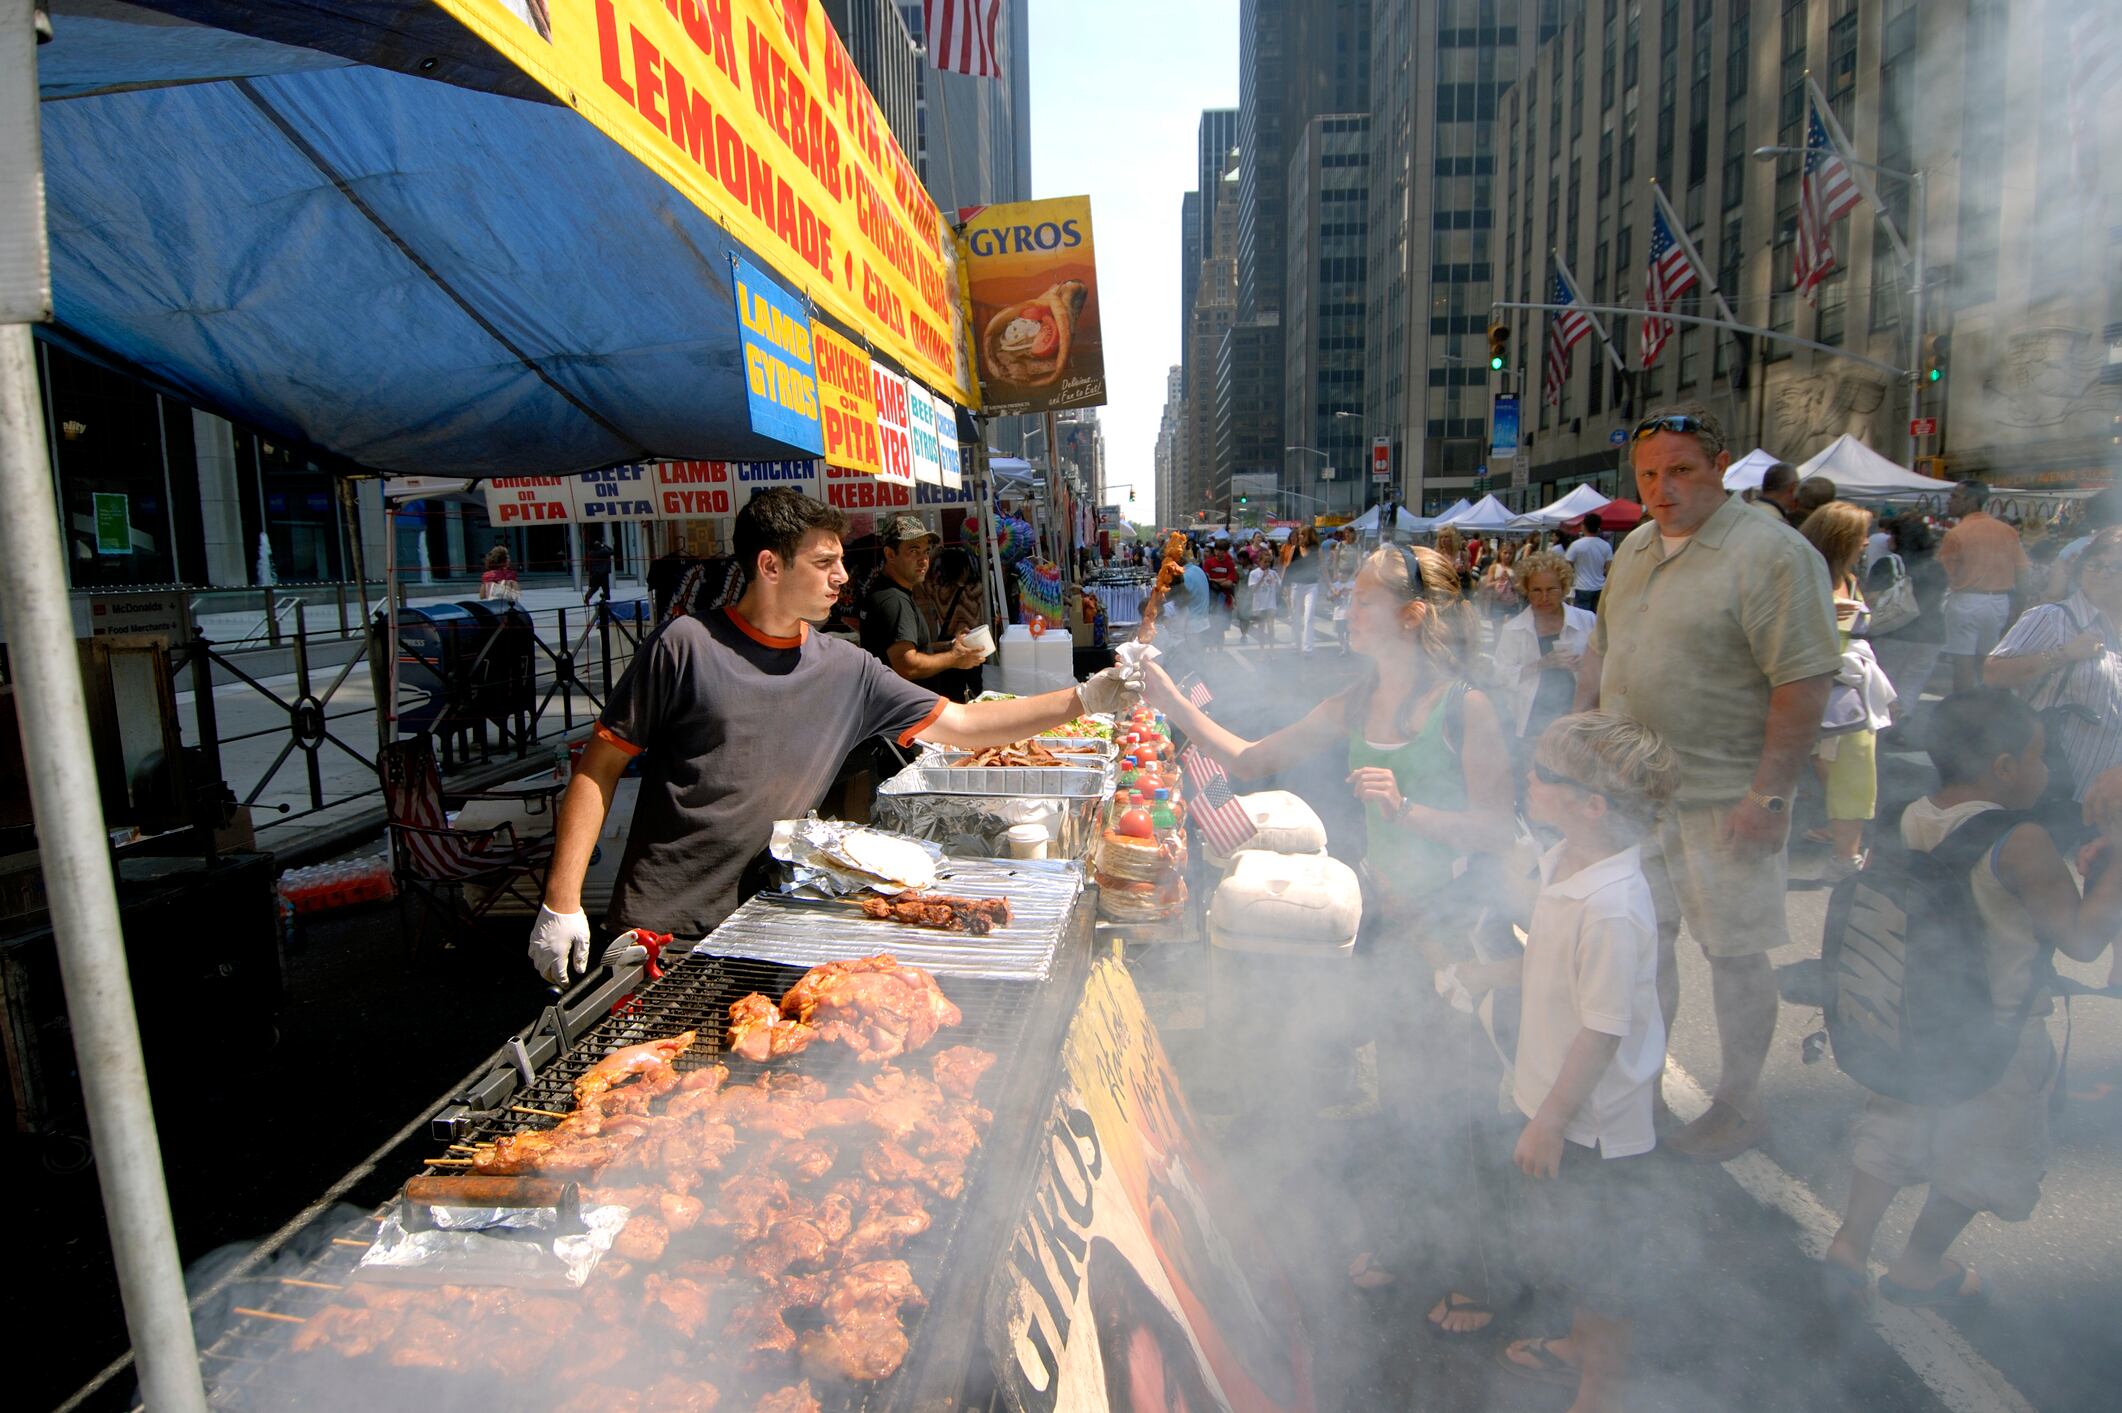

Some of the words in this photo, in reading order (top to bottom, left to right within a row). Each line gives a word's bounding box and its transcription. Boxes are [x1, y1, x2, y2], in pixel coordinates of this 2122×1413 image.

[746, 15, 842, 204] KEBAB
[854, 160, 919, 292] CHICKEN
[595, 0, 834, 284] LEMONADE
[863, 257, 906, 340] COLD
[910, 310, 953, 377] DRINKS
[970, 219, 1082, 257] GYROS
[737, 281, 811, 365] LAMB
[745, 342, 818, 421] GYROS
[815, 334, 872, 404] CHICKEN
[839, 395, 859, 413] ON
[873, 369, 907, 428] AMB
[911, 395, 933, 426] BEEF
[824, 405, 879, 466] PITA
[913, 426, 938, 464] GYROS
[879, 425, 910, 479] YRO
[581, 466, 645, 483] BEEF
[658, 461, 728, 484] LAMB
[738, 459, 815, 481] CHICKEN
[595, 483, 619, 497] ON
[663, 490, 729, 514] GYRO
[827, 482, 909, 508] KEBAB
[499, 501, 568, 521] PITA
[584, 500, 654, 516] PITA
[112, 601, 162, 614] McDonalds
[107, 625, 128, 634] Food
[130, 622, 170, 633] Merchants
[1004, 1109, 1102, 1413] GYROS
